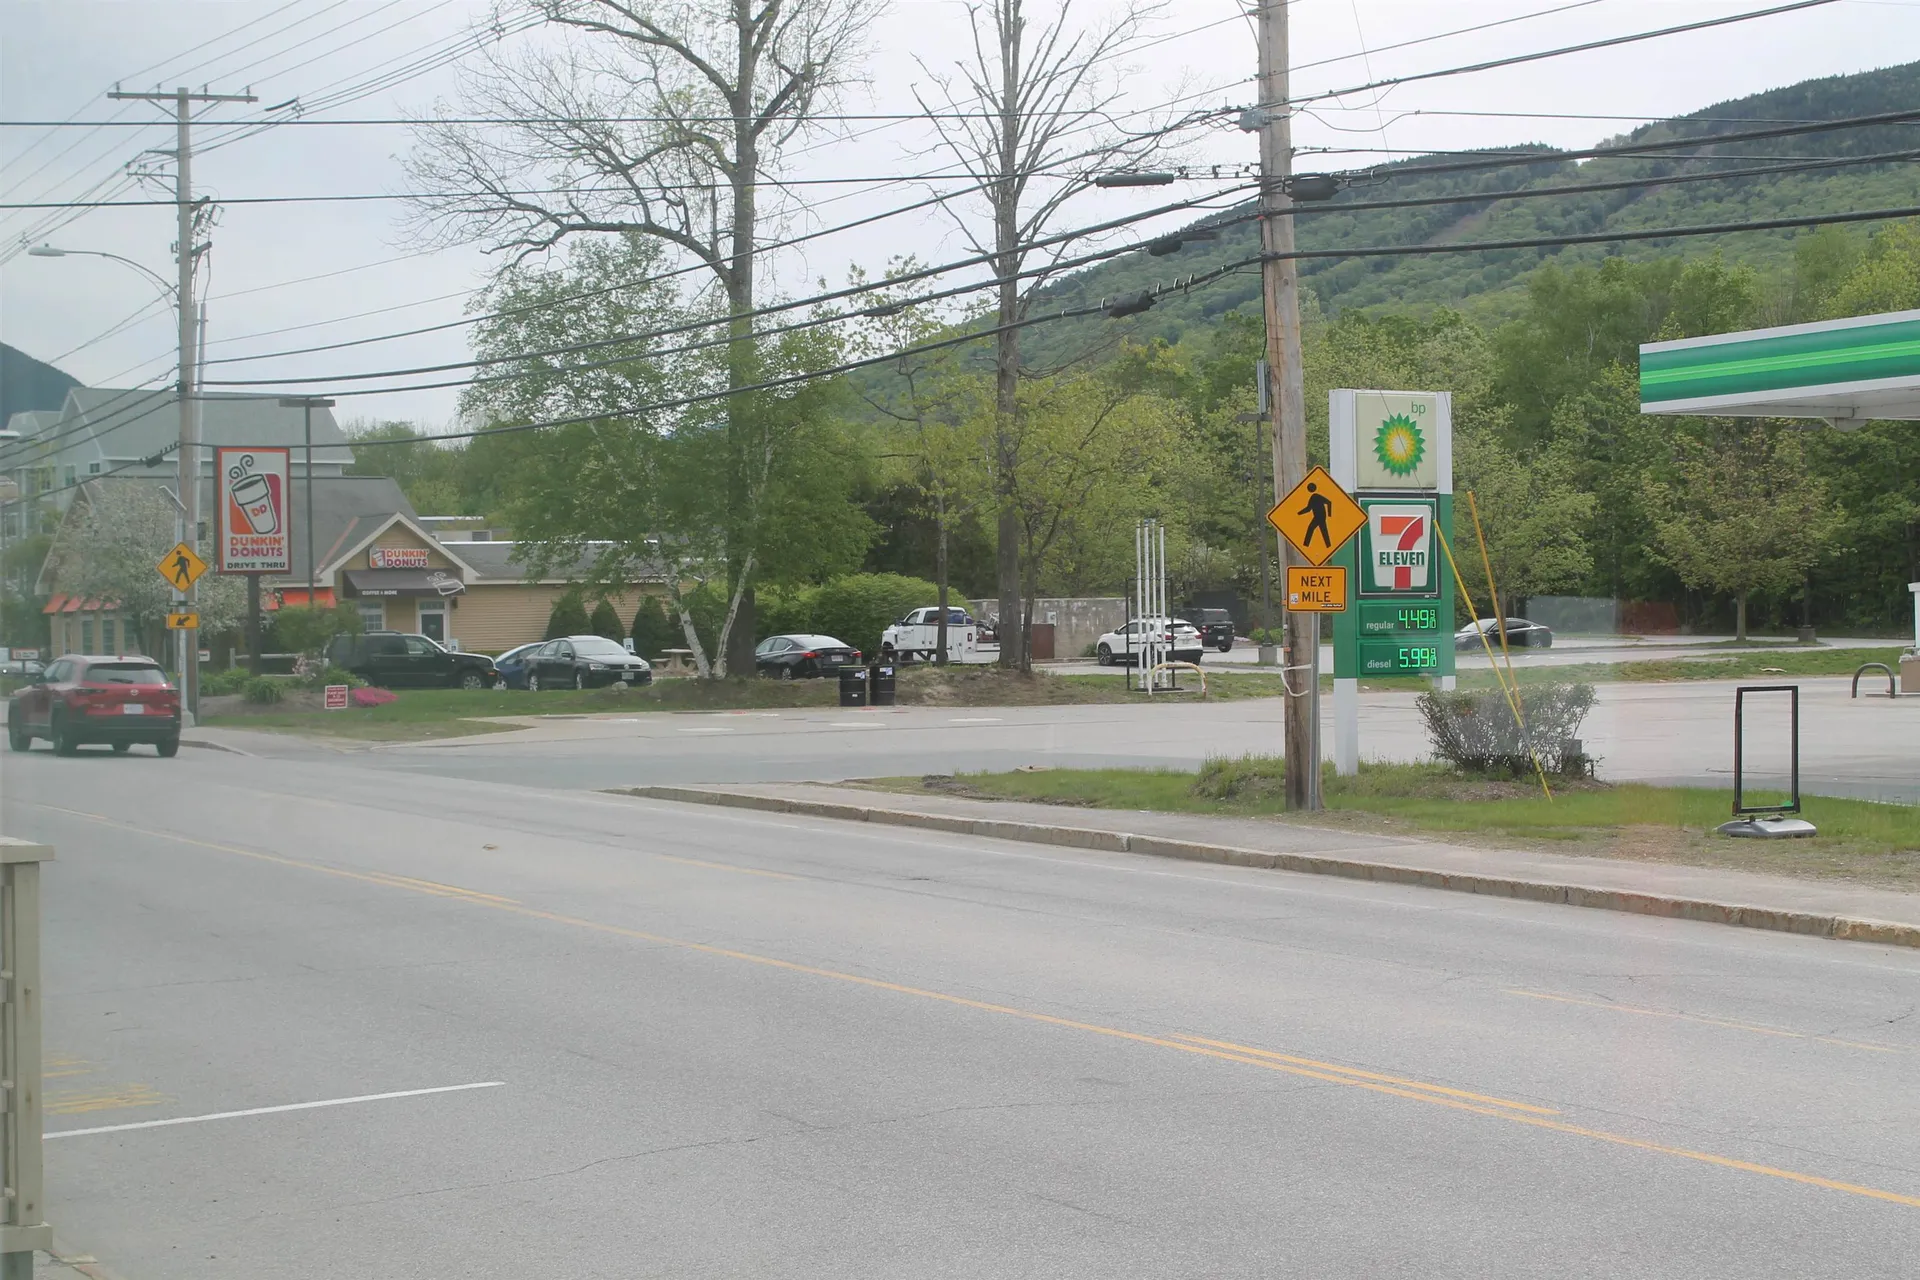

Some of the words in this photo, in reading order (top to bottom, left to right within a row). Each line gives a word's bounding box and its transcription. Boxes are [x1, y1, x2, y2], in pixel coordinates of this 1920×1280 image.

[1411, 401, 1426, 416] bp
[251, 504, 267, 517] DD
[230, 536, 284, 547] DUNKIN'
[230, 547, 283, 557] DONUTS
[386, 549, 428, 558] DUNKIN'
[1380, 515, 1424, 590] 7
[386, 558, 428, 567] DONUTS
[1379, 551, 1425, 566] ELEVEN
[227, 561, 257, 569] DRIVE
[260, 561, 286, 569] THRU
[1301, 576, 1332, 587] NEXT
[1301, 591, 1332, 603] MILE
[1366, 620, 1394, 631] regular
[1367, 659, 1391, 669] diesel
